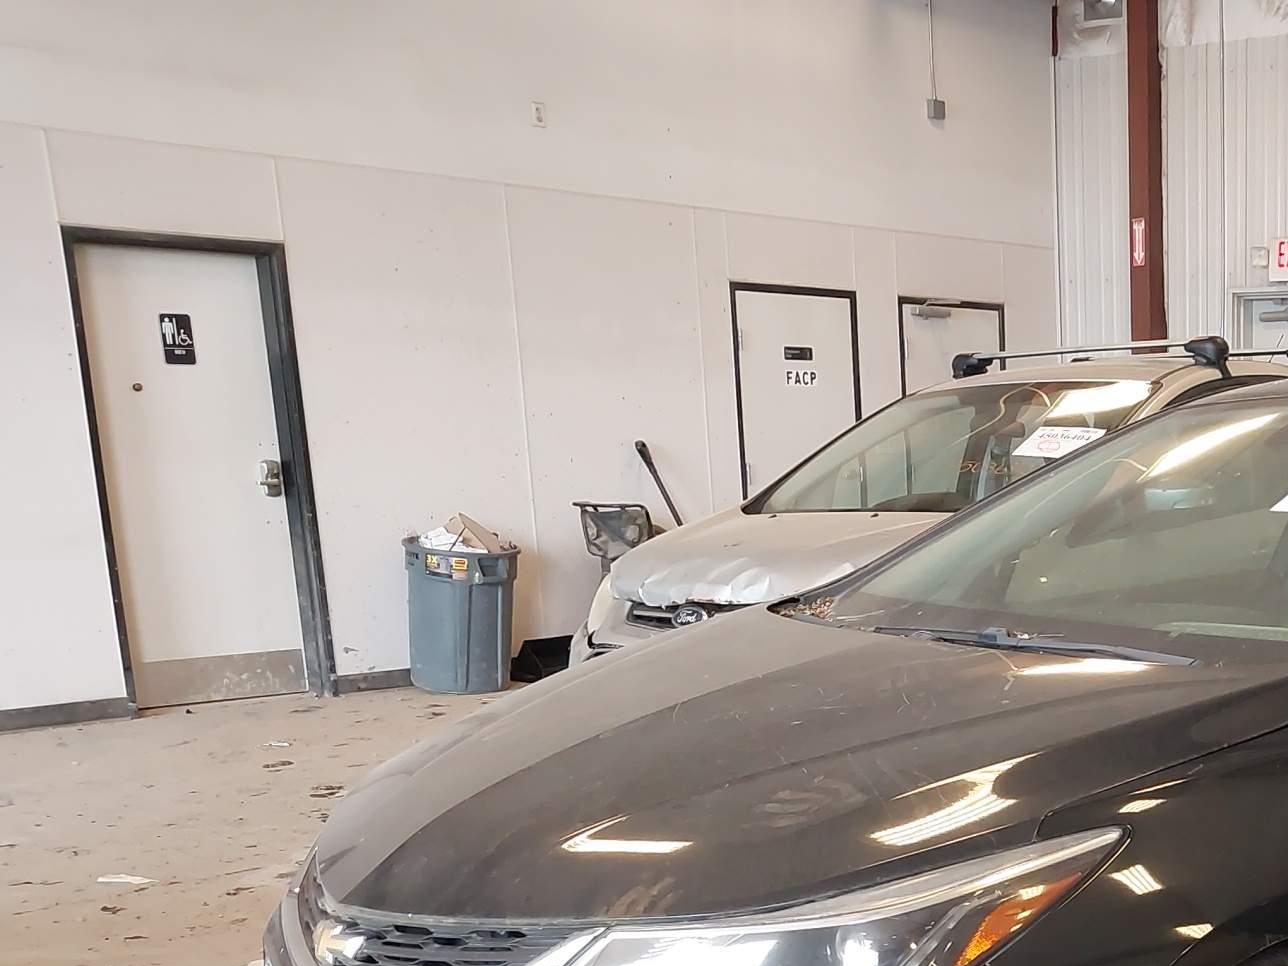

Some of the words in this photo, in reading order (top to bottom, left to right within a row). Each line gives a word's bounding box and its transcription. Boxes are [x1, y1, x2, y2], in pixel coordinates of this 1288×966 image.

[786, 370, 817, 386] FACP
[426, 554, 439, 563] 3X
[677, 610, 698, 623] Ford
